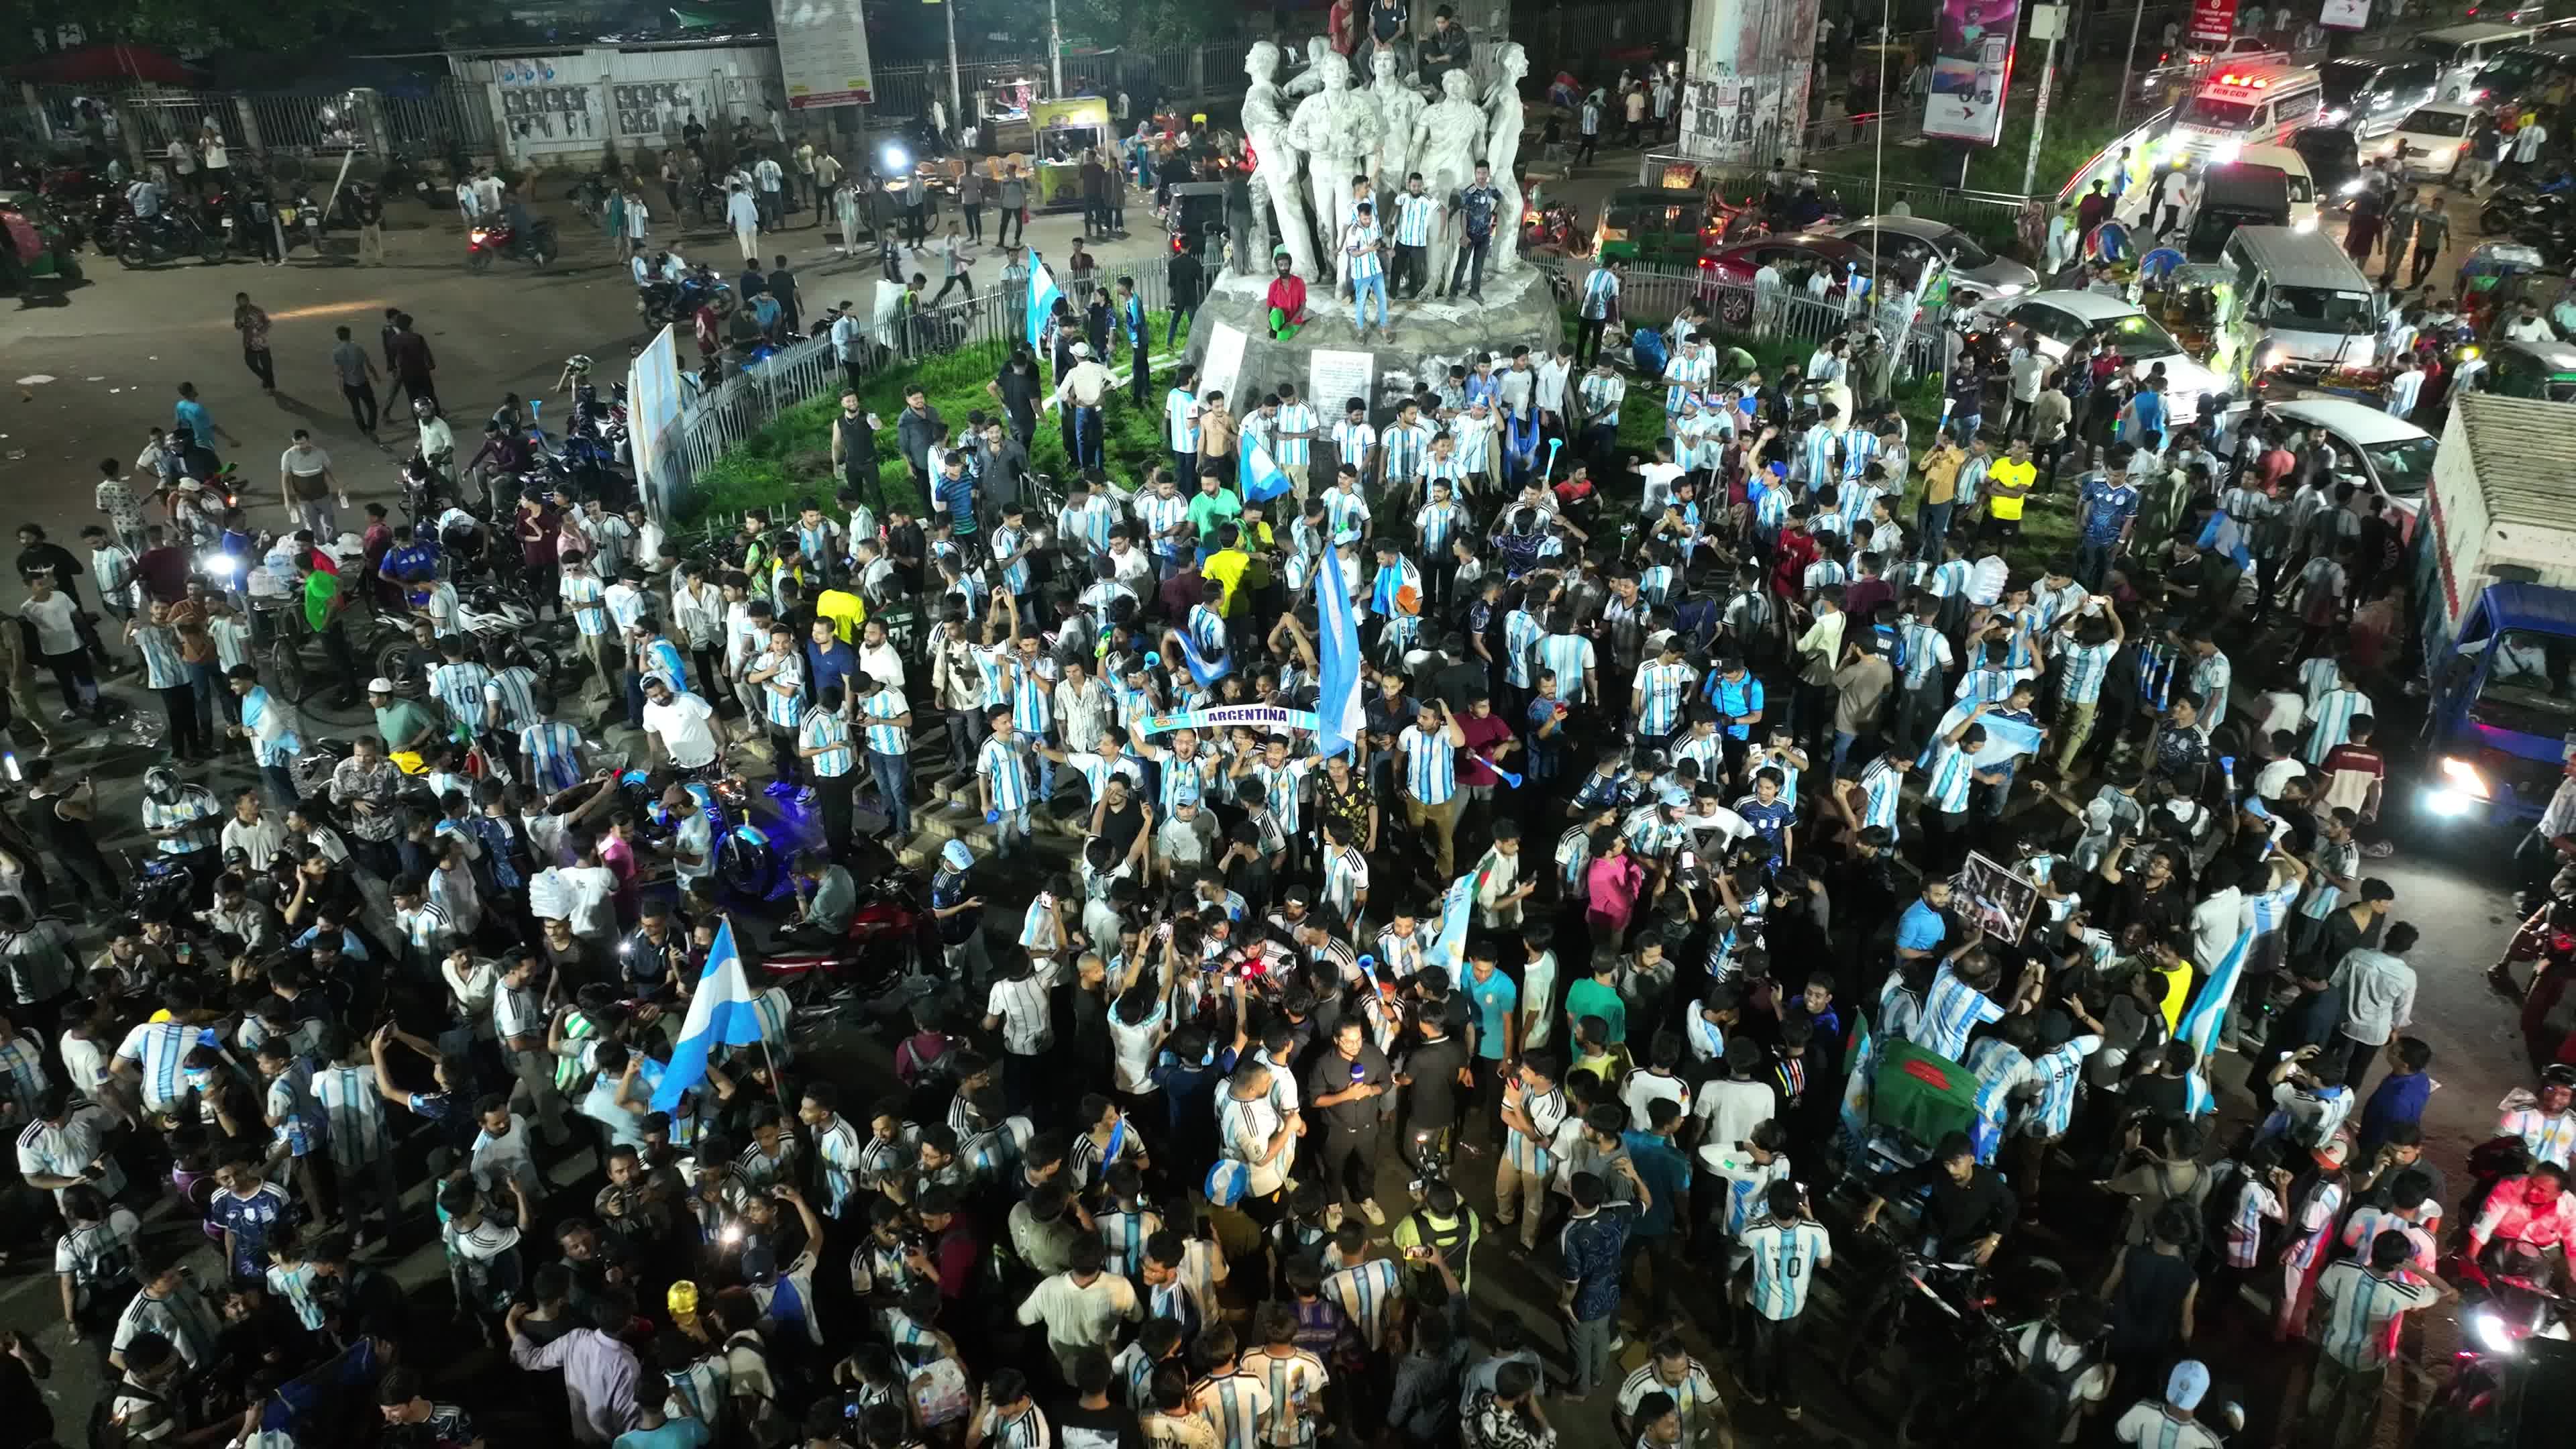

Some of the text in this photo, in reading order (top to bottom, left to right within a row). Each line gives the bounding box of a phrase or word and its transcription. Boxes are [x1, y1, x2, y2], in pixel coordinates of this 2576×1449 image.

[1509, 631, 1521, 653] 10
[455, 686, 476, 704] 10
[1208, 708, 1287, 722] ARGENTINA
[1773, 1256, 1801, 1282] 10
